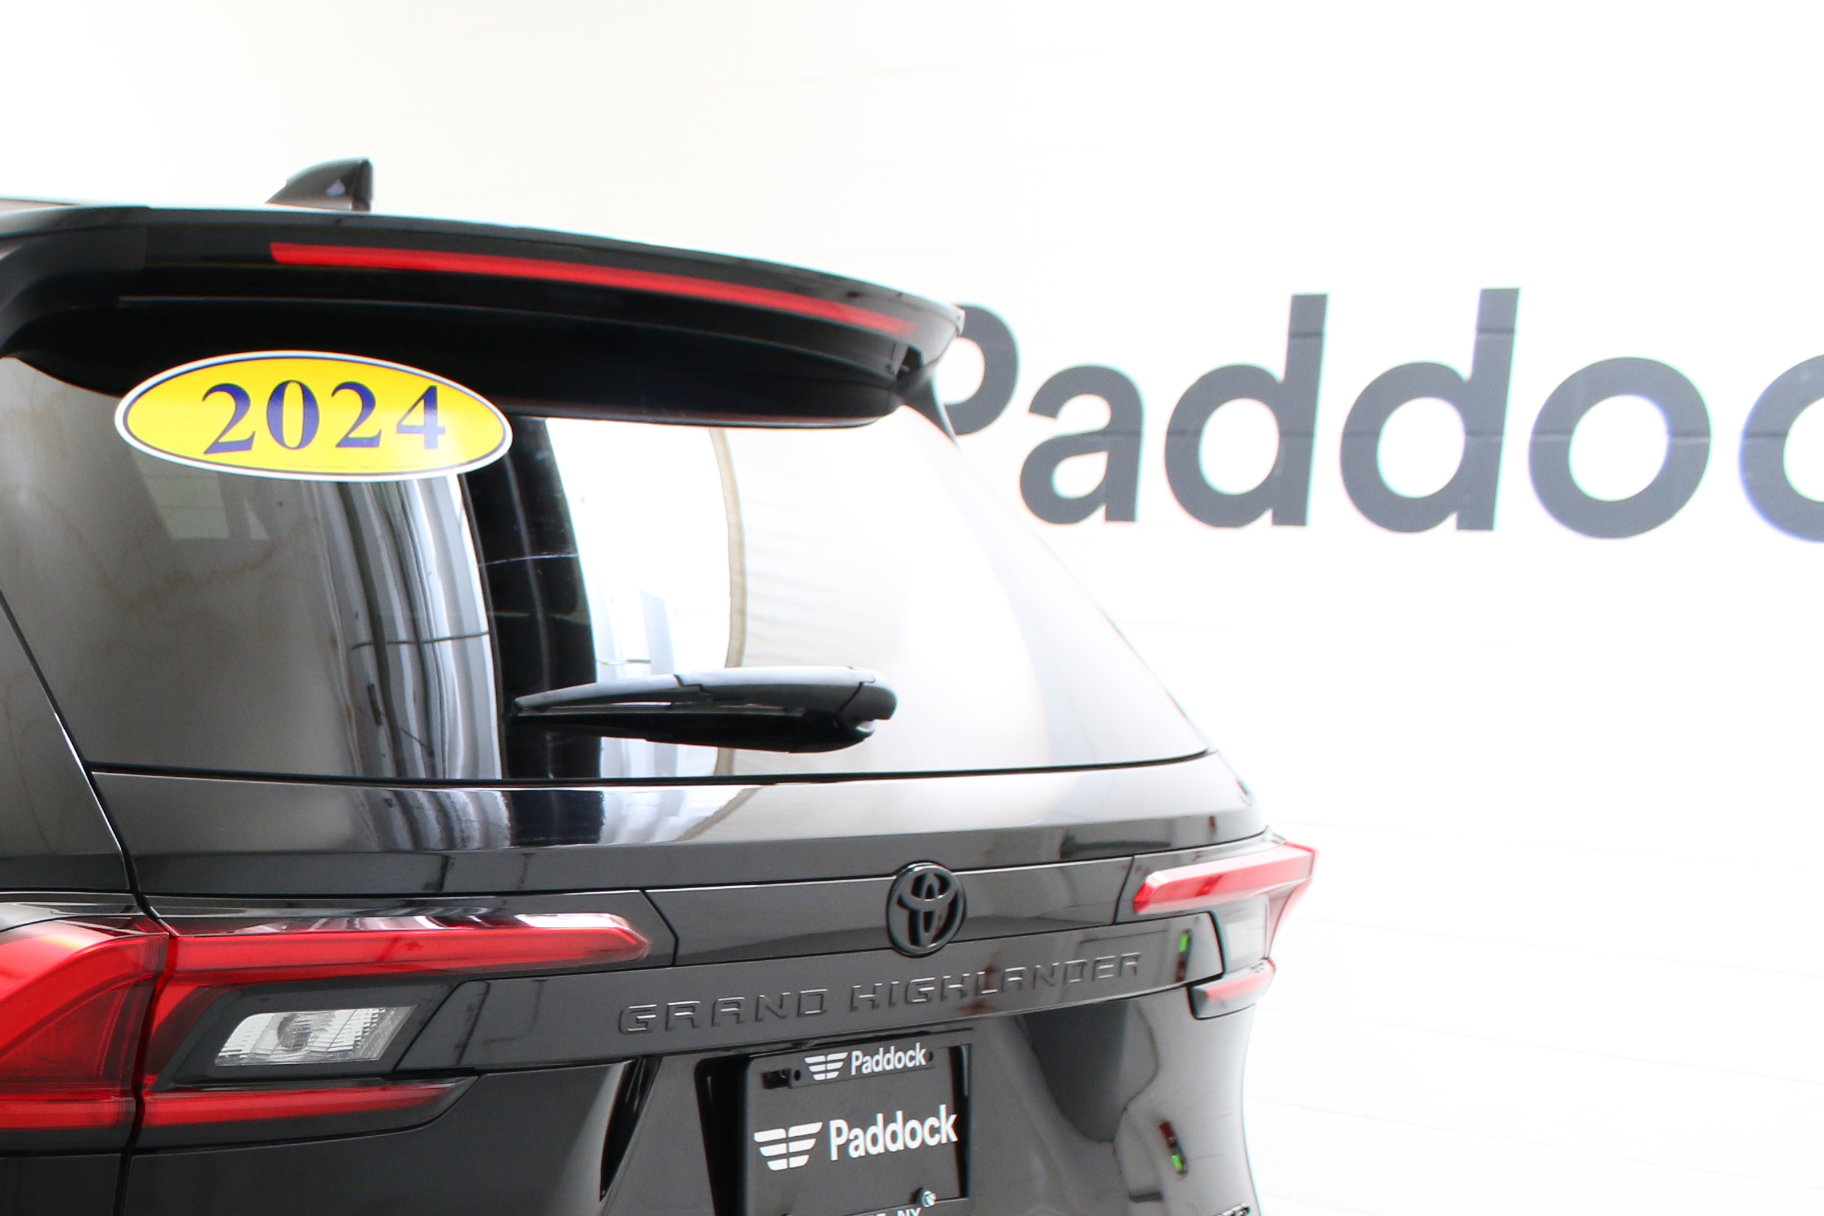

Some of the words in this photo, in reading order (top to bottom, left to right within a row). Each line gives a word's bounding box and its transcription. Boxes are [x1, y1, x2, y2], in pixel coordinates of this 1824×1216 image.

[202, 380, 446, 454] 2024
[619, 987, 829, 1035] GRAND
[850, 952, 1142, 1013] HIGHLANDER
[850, 1042, 927, 1076] Paddock
[829, 1103, 959, 1161] Paddock
